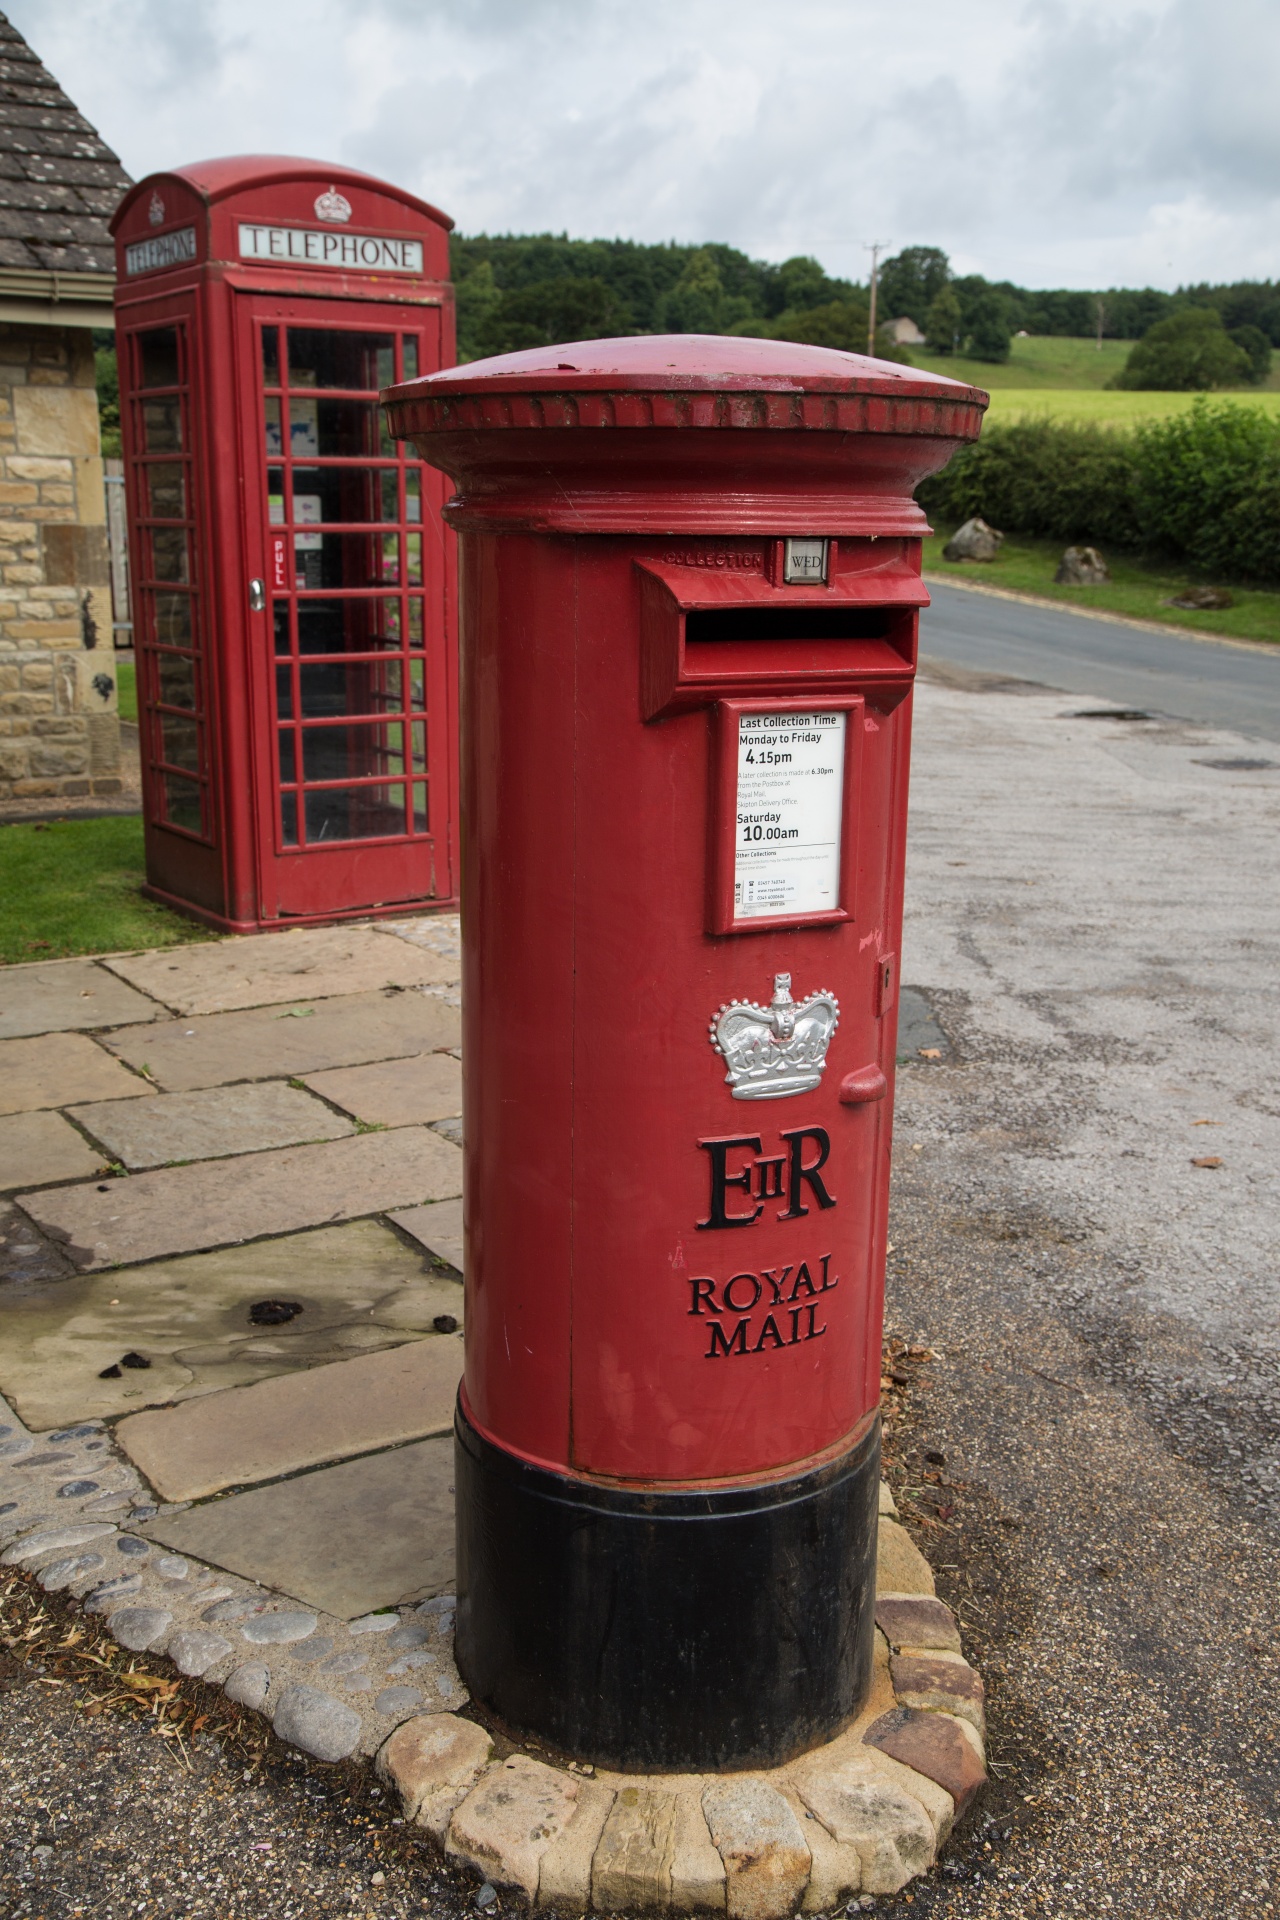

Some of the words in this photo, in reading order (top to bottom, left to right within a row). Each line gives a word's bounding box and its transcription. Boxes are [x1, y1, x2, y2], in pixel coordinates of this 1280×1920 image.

[128, 230, 195, 272] TELEPHONE
[245, 227, 415, 269] TELEPHONE
[274, 540, 284, 585] PULL
[664, 551, 762, 568] COLLECTION
[792, 556, 821, 568] WED
[740, 718, 761, 728] Last
[763, 716, 810, 727] Collection
[812, 715, 837, 725] Time
[739, 734, 777, 746] Monday
[780, 735, 789, 743] to
[791, 732, 822, 743] Friday
[745, 748, 792, 765] 4.15pm
[757, 770, 782, 778] collection
[811, 767, 834, 775] 6.30pm
[738, 791, 752, 799] Royal
[758, 799, 781, 807] Delivery
[737, 812, 781, 824] Saturday
[743, 825, 799, 841] 10.00am
[687, 1252, 839, 1315] ROYAL
[704, 1300, 827, 1358] MAIL
